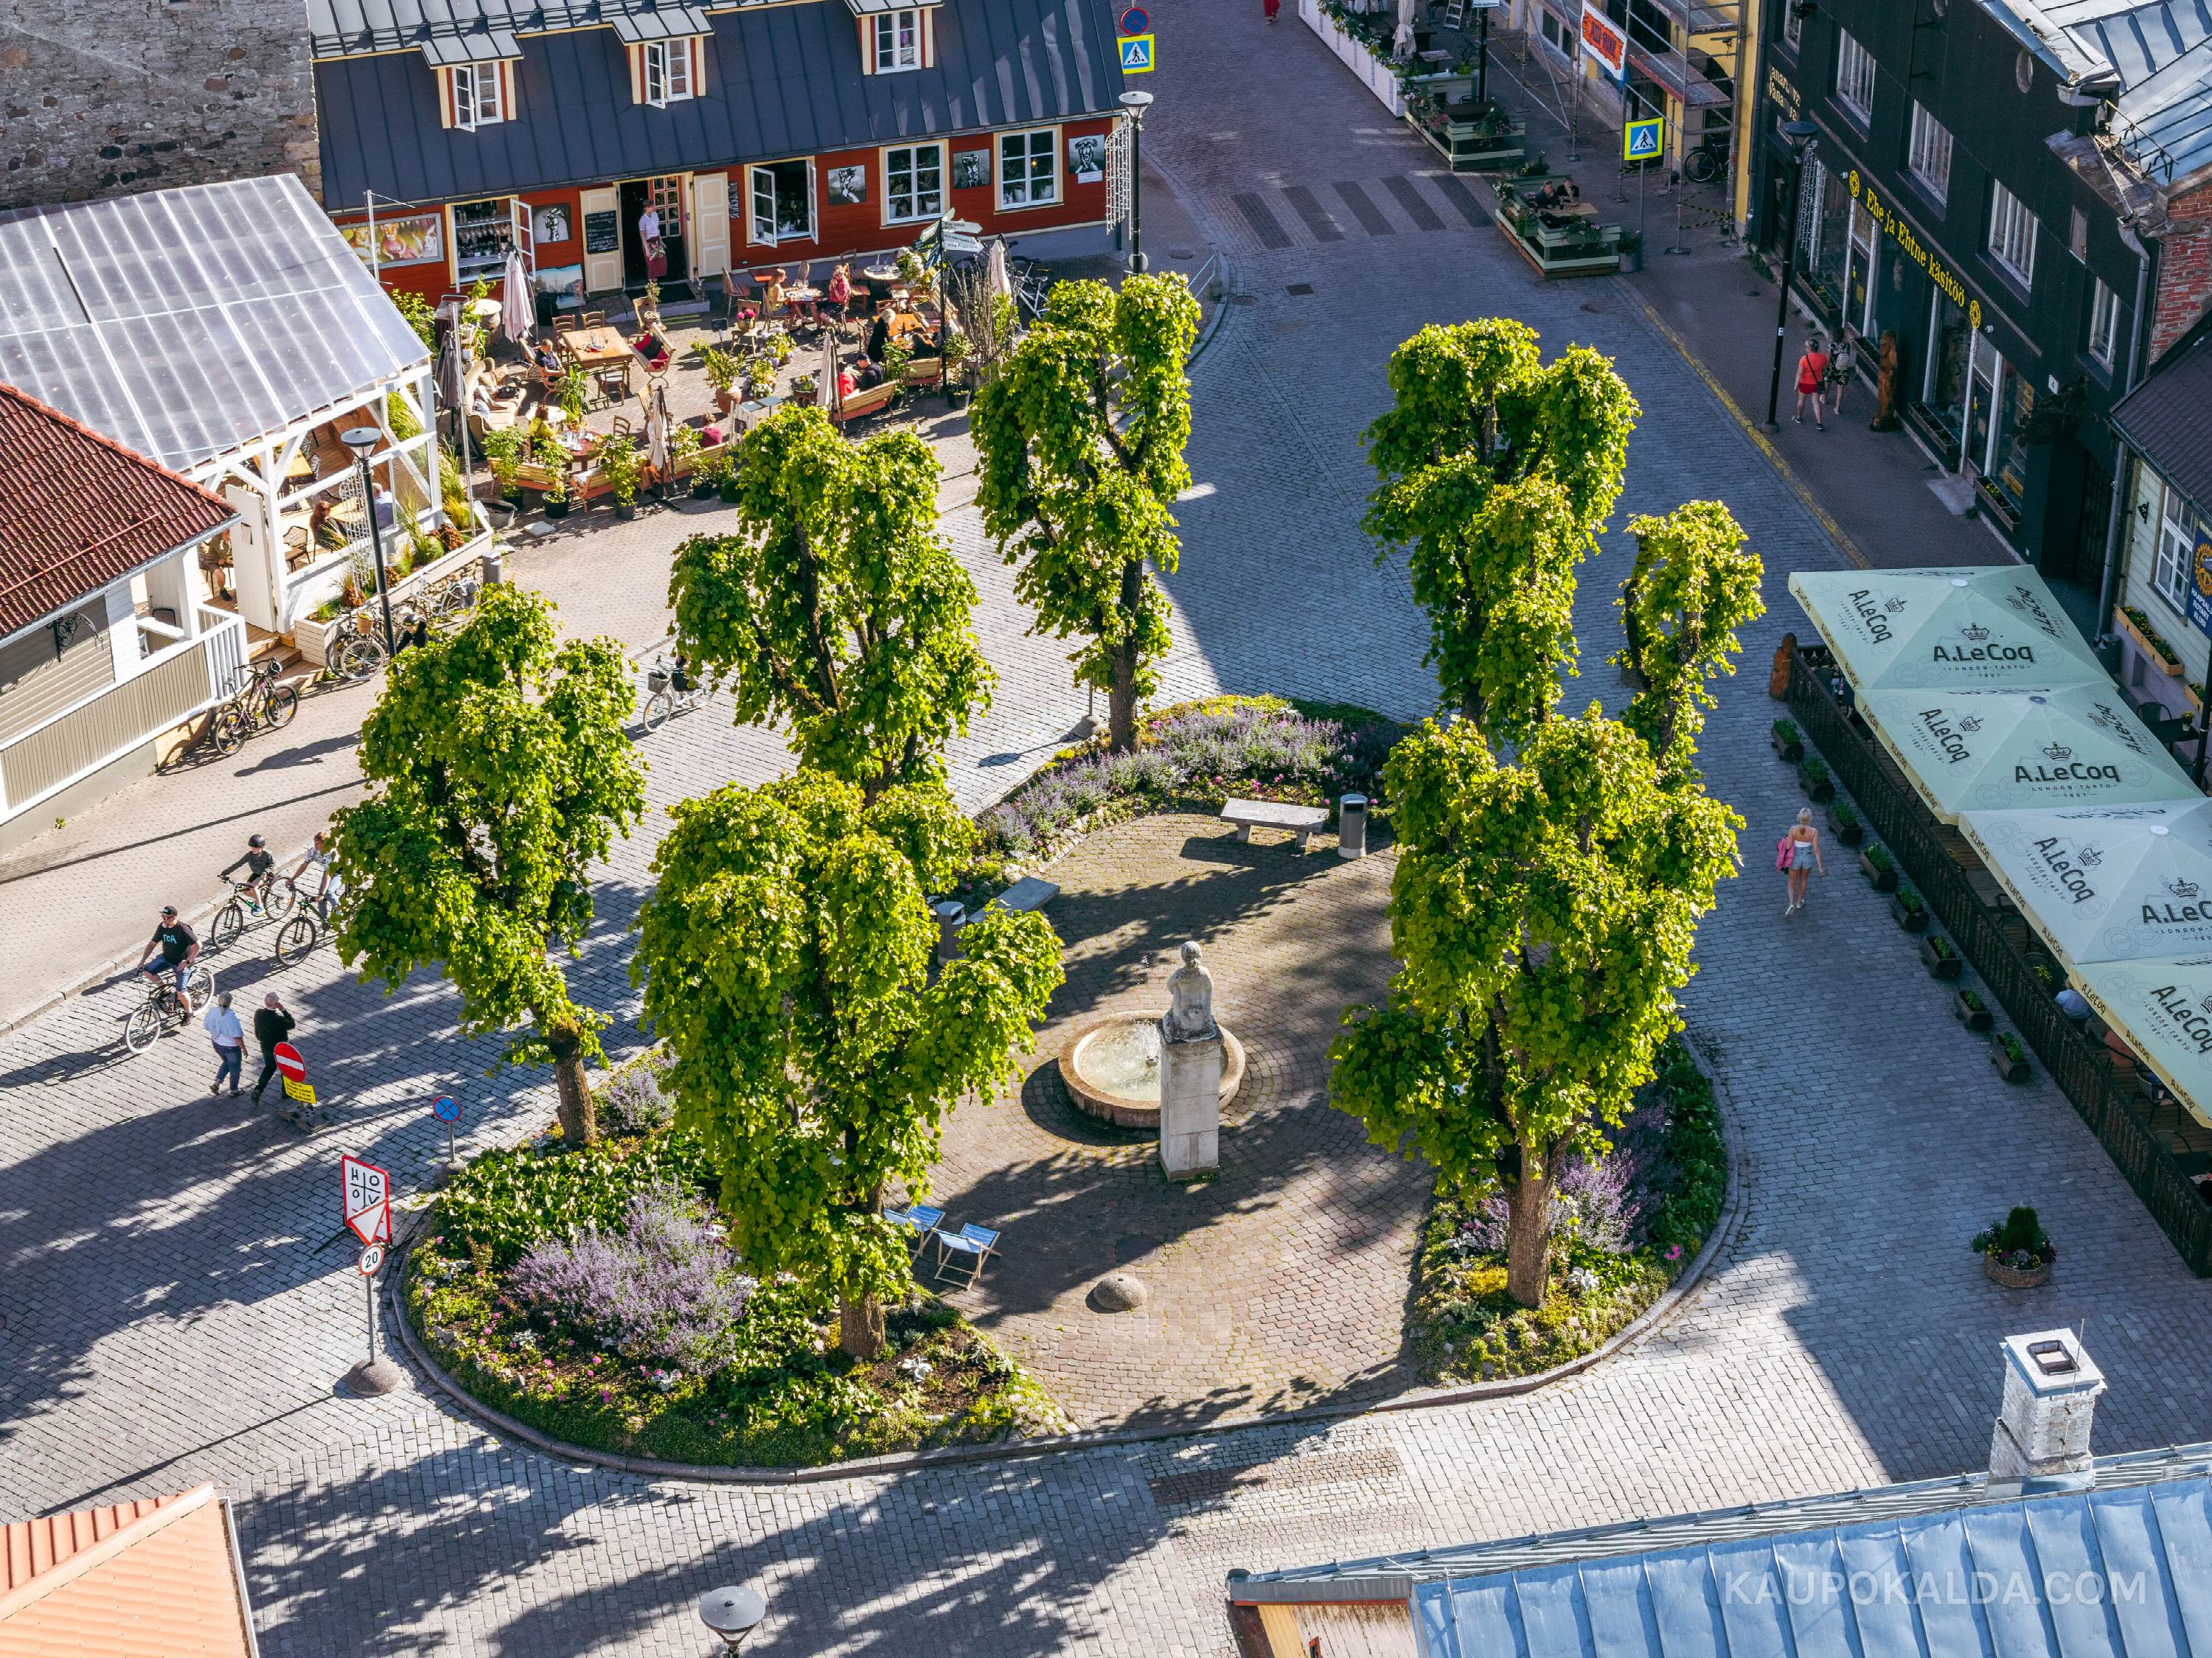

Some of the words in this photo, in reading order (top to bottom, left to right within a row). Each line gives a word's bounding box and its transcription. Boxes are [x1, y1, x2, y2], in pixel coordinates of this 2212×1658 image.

[1867, 188, 1884, 222] Ehe
[1885, 210, 1895, 234] ja
[1897, 221, 1927, 267] Ehtne
[1928, 254, 1964, 307] käsitöö
[1848, 590, 1893, 644] A.LeCoq
[2193, 599, 2209, 620] ROTARY
[2194, 610, 2206, 628] KLUBI
[1933, 644, 2034, 663] A.LeCoq
[1919, 708, 1971, 764] A.LeCoq
[2015, 763, 2120, 783] A.LeCoq
[2034, 837, 2095, 904] A.LeCoq
[2171, 1079, 2195, 1110] A.LeCoq
[365, 1252, 378, 1268] 20
